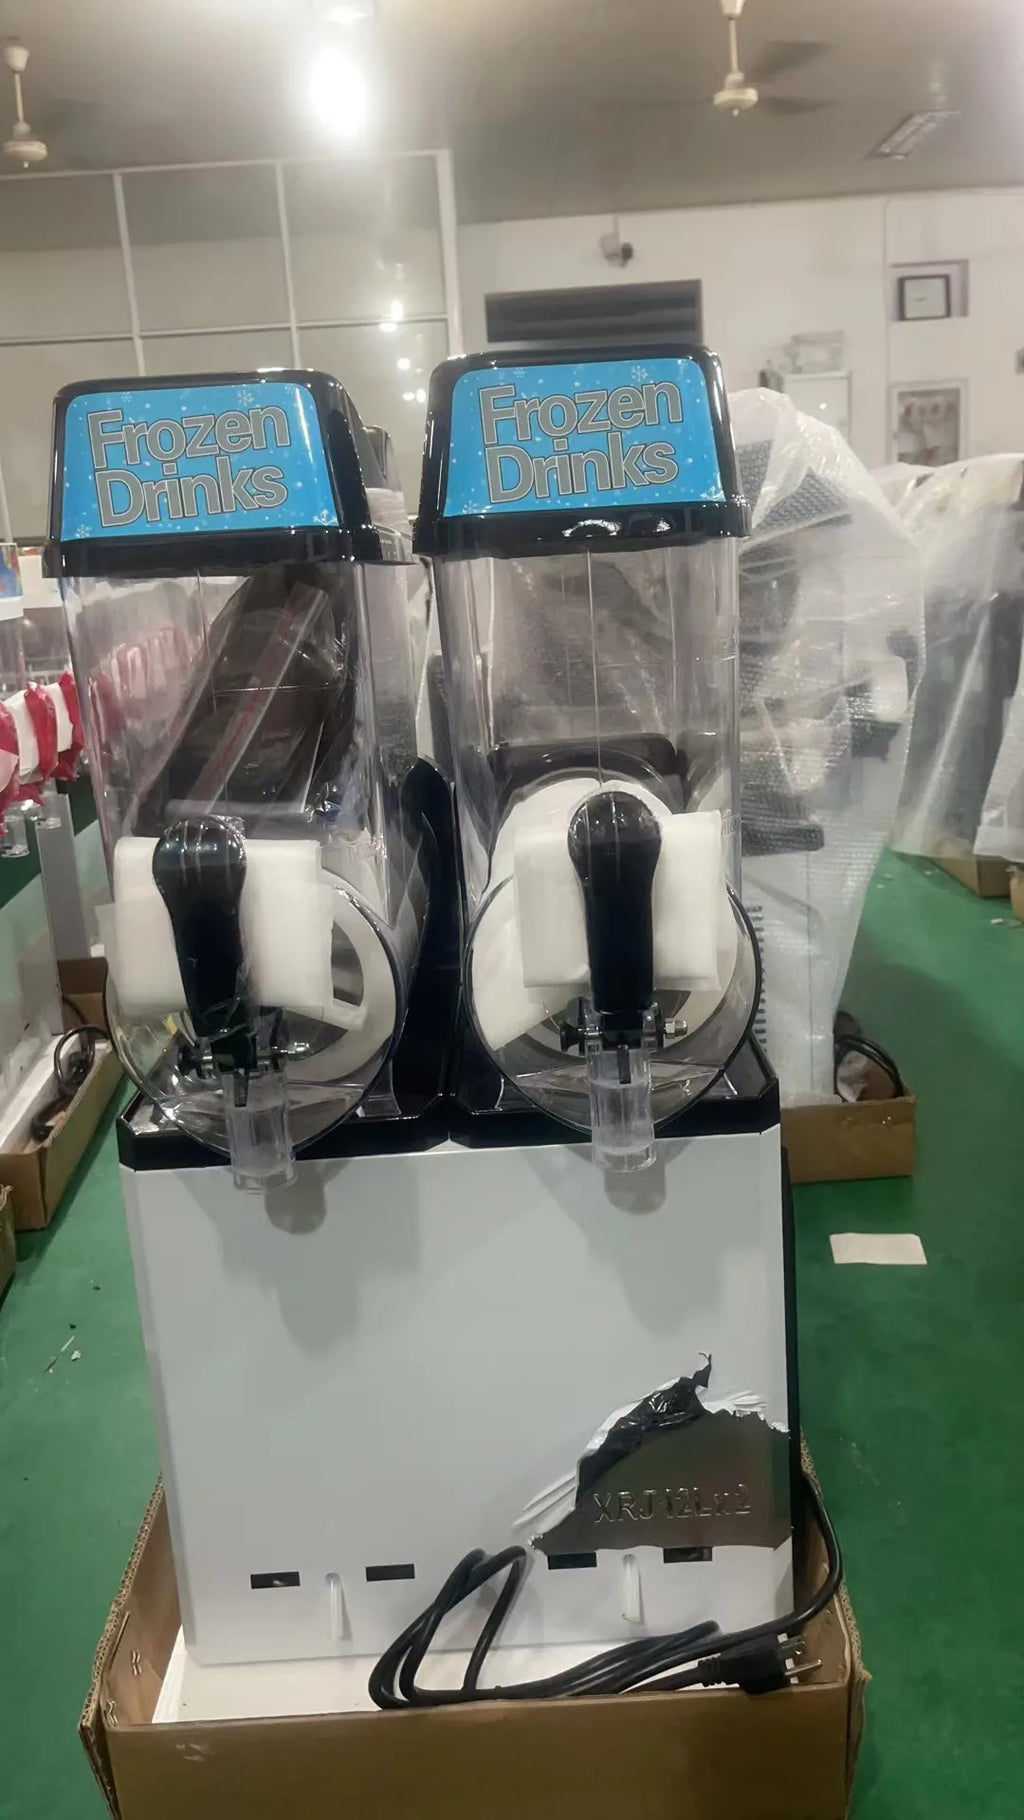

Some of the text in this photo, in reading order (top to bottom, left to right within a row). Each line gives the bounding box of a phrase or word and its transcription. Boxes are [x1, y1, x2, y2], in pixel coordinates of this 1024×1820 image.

[87, 405, 291, 469] Frozen
[479, 380, 683, 445] Frozen
[95, 455, 288, 527] Drinks
[484, 431, 679, 504] Drinks
